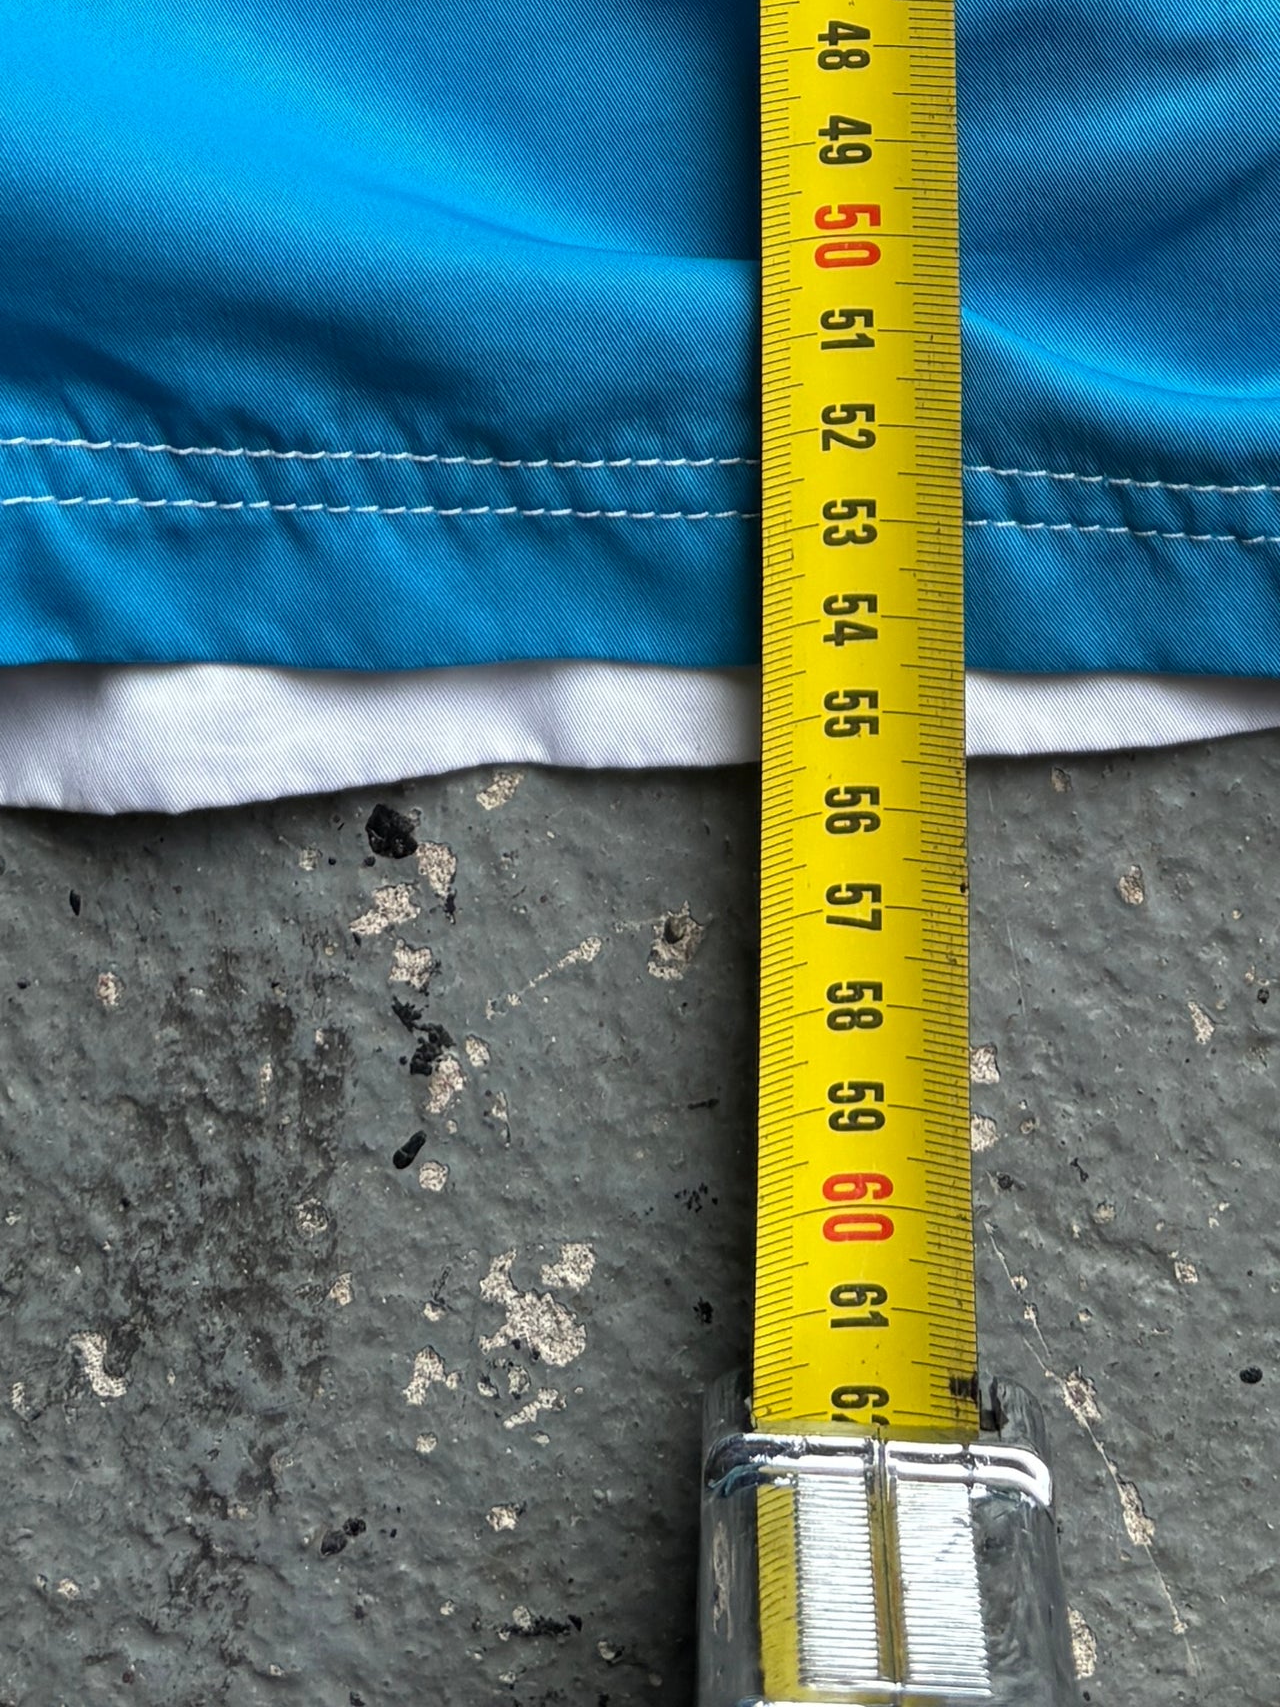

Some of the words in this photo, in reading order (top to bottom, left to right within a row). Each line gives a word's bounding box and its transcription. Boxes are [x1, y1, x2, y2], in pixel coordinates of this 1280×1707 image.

[817, 20, 871, 71] 48
[818, 115, 872, 165] 49
[813, 203, 882, 270] 50
[820, 308, 875, 350] 51
[821, 403, 876, 452] 52
[822, 499, 878, 547] 53
[823, 594, 878, 647] 54
[823, 689, 880, 738] 55
[824, 786, 881, 835] 56
[825, 883, 882, 931] 57
[826, 981, 884, 1032] 58
[827, 1081, 886, 1132] 59
[821, 1172, 894, 1243] 60
[830, 1283, 889, 1329] 61
